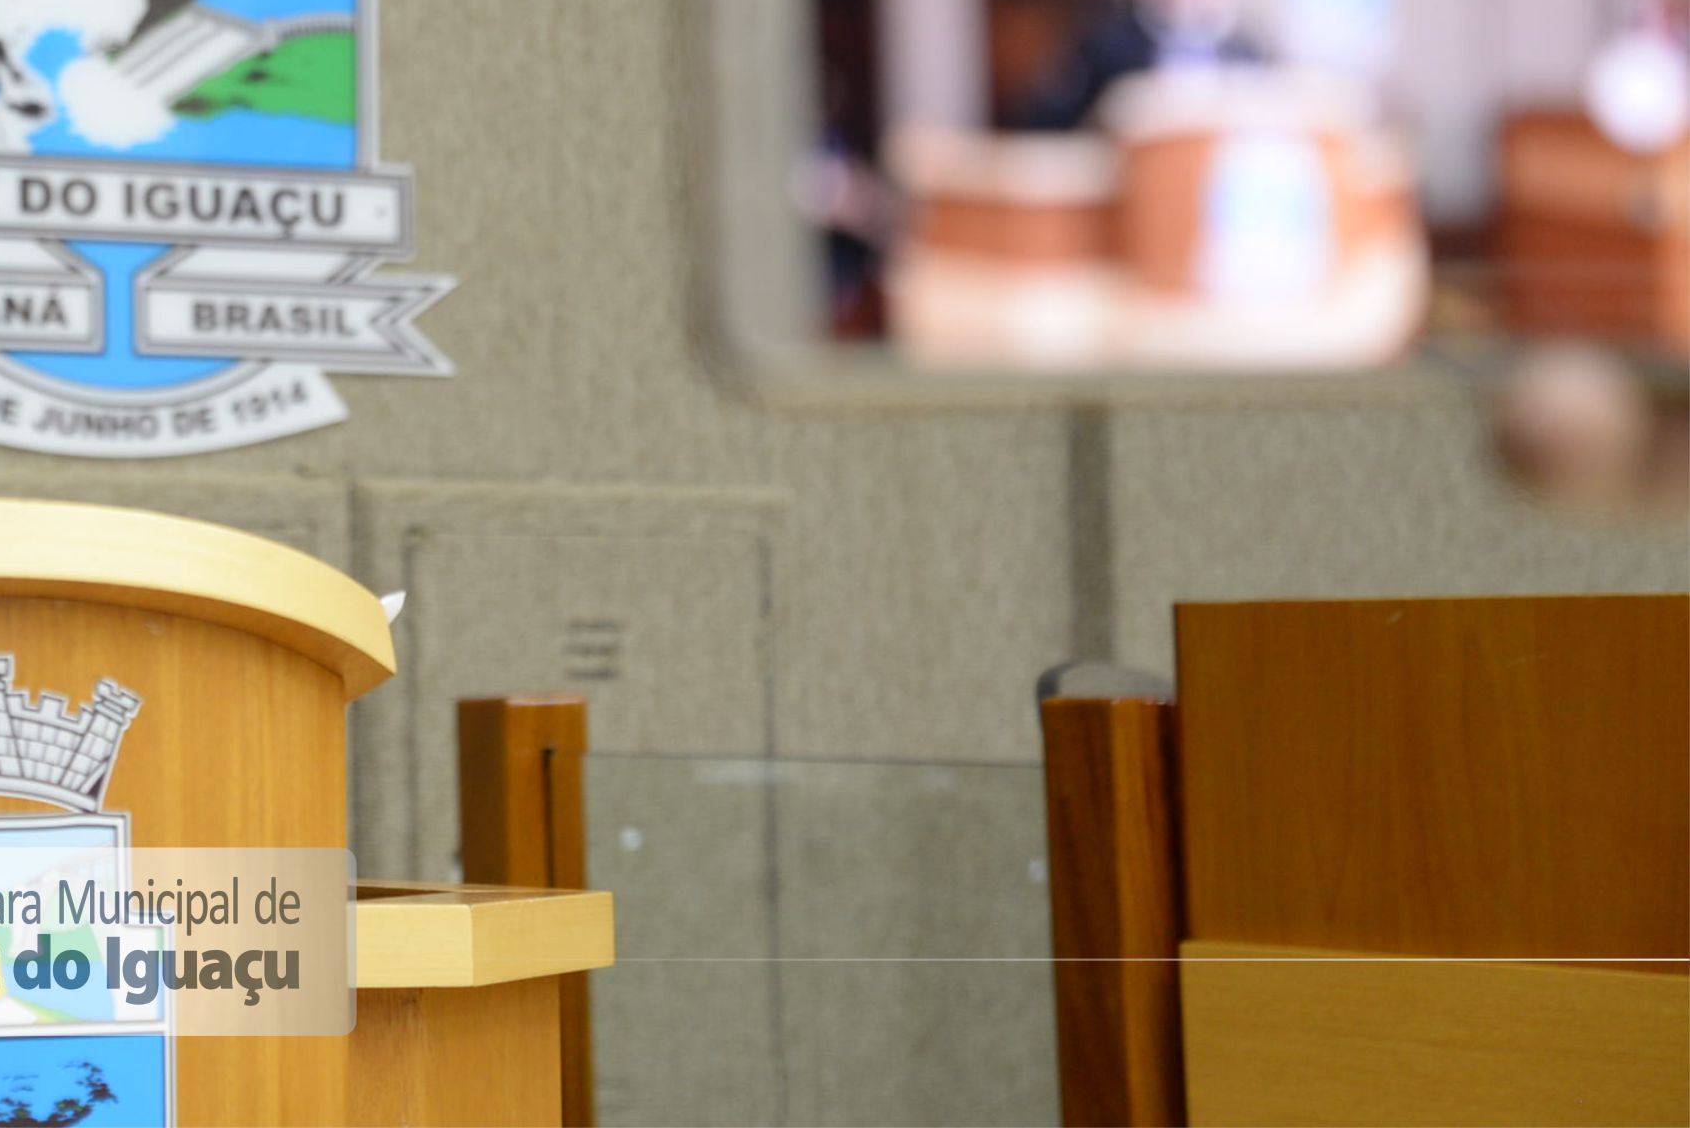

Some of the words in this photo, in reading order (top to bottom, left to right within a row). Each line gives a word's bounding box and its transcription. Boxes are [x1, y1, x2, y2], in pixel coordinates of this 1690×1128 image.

[19, 177, 98, 216] DO
[124, 182, 345, 239] IGUAÇU
[192, 302, 356, 336] BRASIL
[33, 406, 158, 439] JUNHO
[171, 408, 215, 437] DE
[231, 378, 308, 423] 1914
